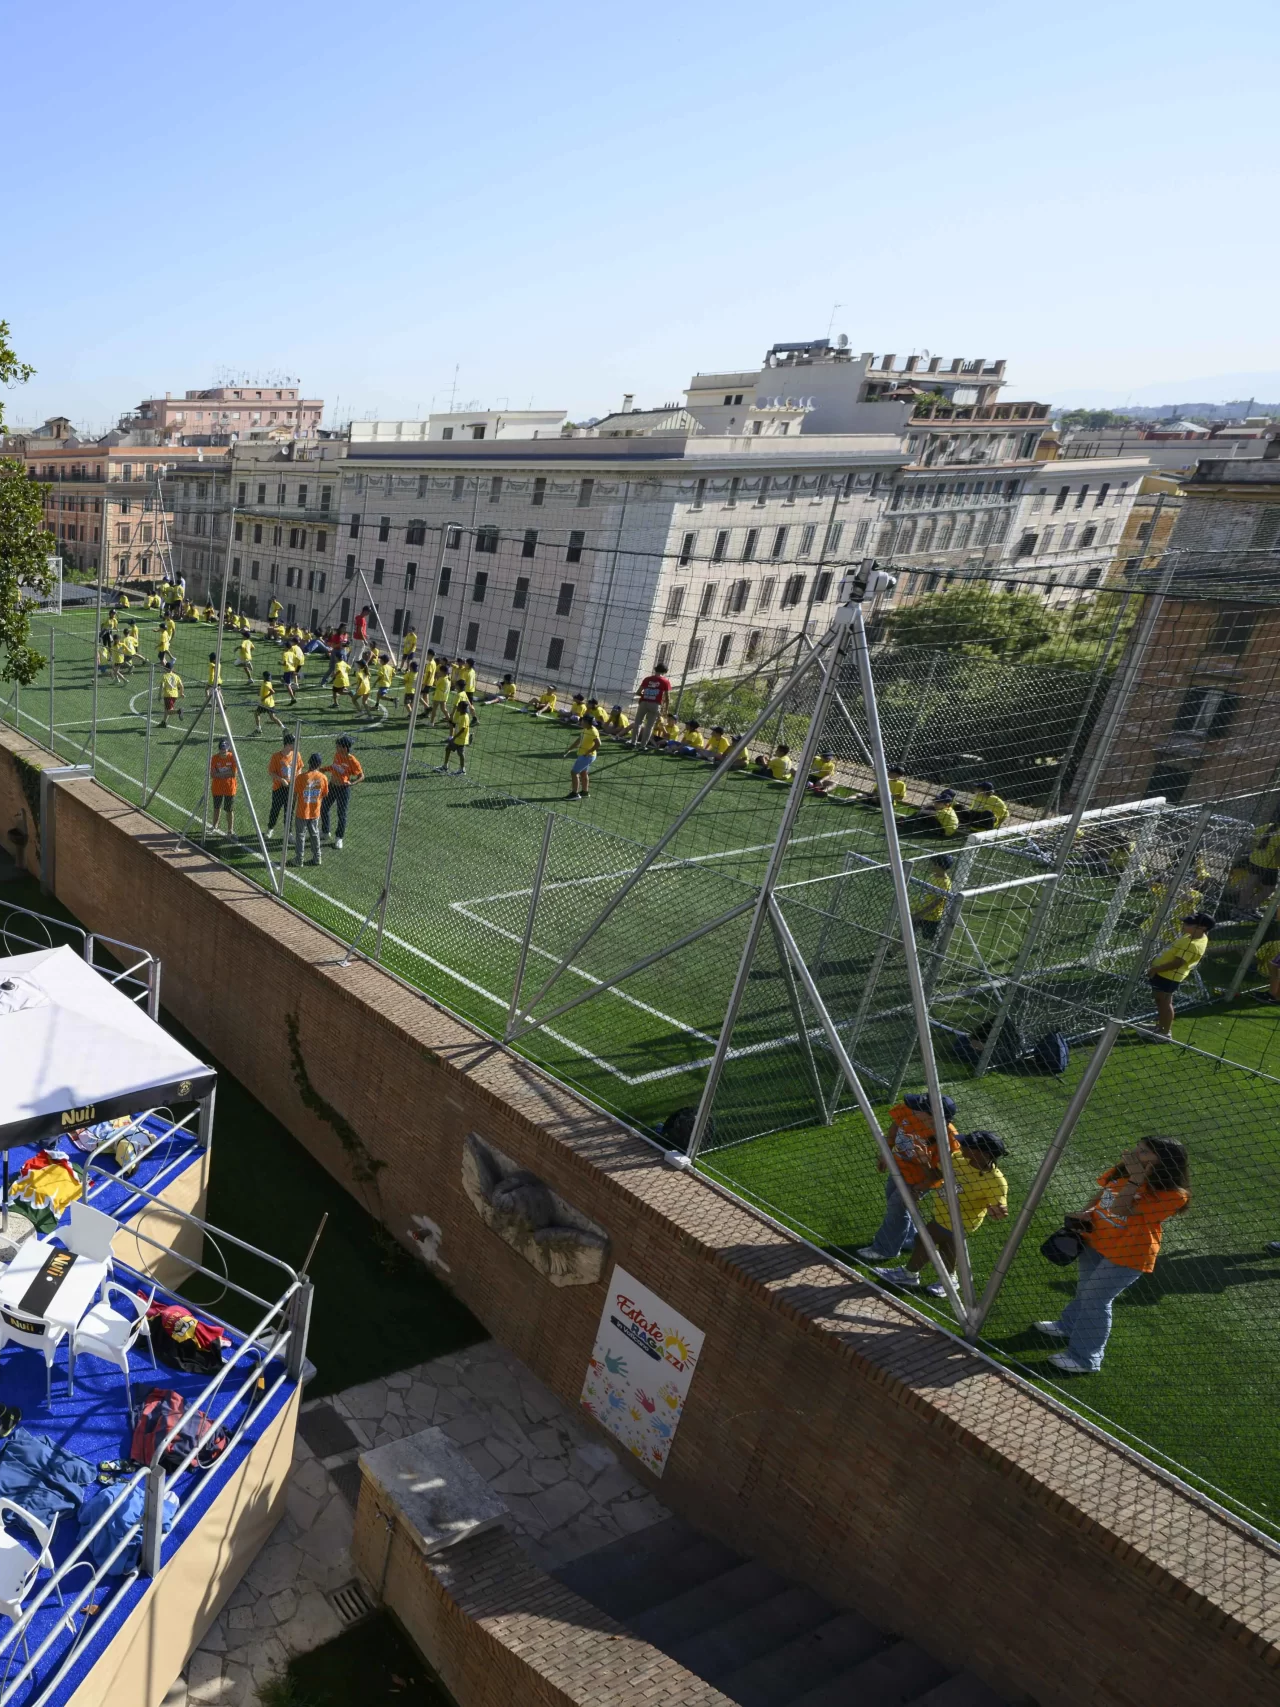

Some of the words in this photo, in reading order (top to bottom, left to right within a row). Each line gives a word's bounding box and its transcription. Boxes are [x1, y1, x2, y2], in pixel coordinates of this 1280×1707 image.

[61, 1104, 96, 1126] Nuii
[46, 1253, 71, 1277] Nuii
[10, 1317, 35, 1332] Nuii
[616, 1294, 664, 1343] Estate
[630, 1322, 685, 1373] RAGAZZI
